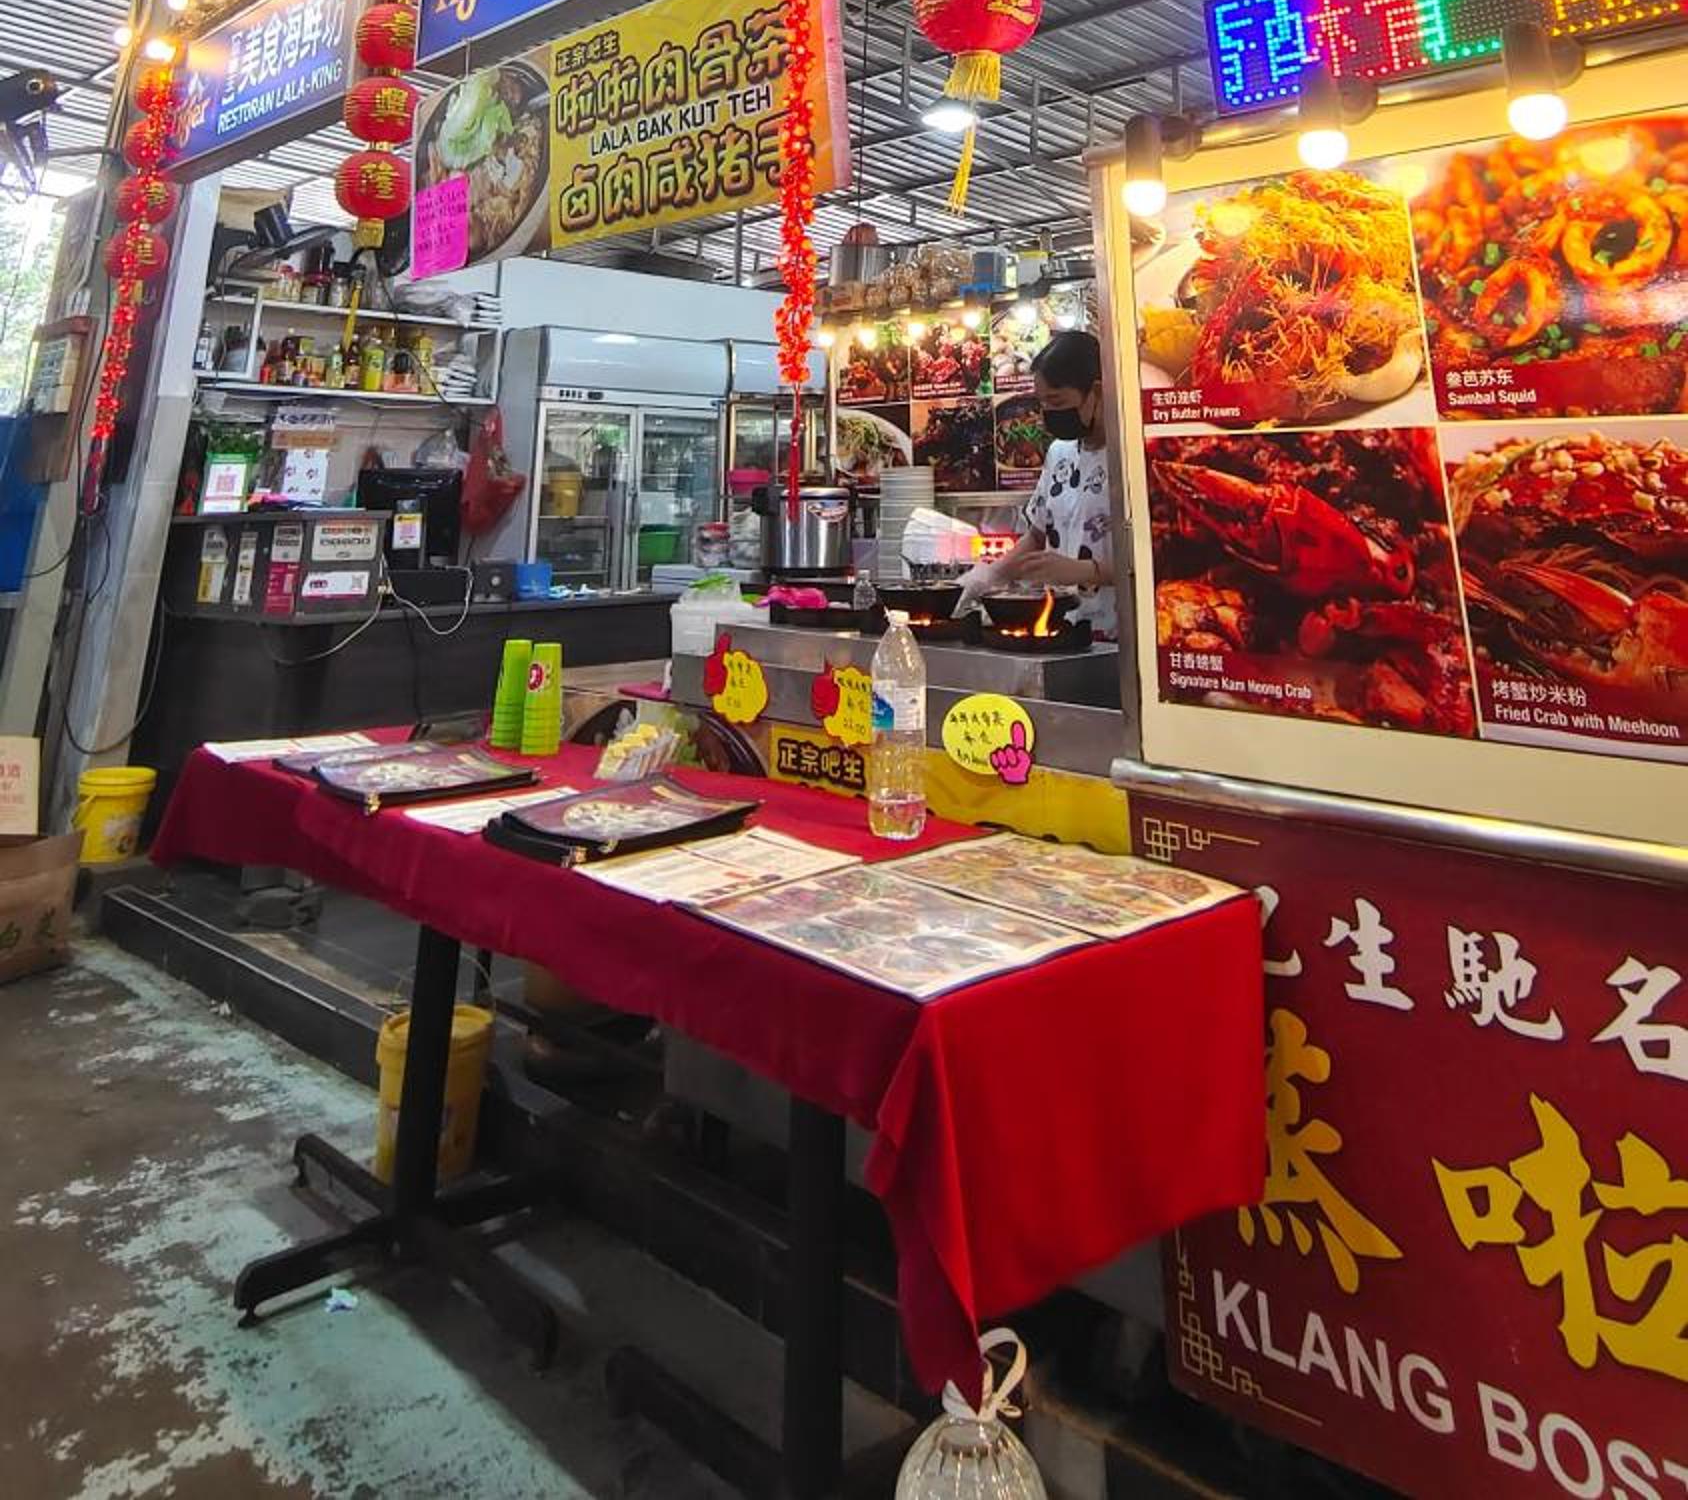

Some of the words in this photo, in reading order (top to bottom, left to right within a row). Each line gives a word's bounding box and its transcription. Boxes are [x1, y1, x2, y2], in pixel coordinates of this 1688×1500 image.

[556, 31, 620, 75] 正宗吧生
[557, 1, 793, 137] 啦啦肉骨茶
[217, 90, 275, 135] RESTORAN
[275, 59, 343, 108] LALA-KING
[590, 127, 633, 157] LALA
[638, 114, 673, 143] BAK
[679, 101, 719, 131] KUT
[728, 85, 772, 114] TEH
[1152, 409, 1169, 422] Dry
[1171, 407, 1201, 420] Butter
[1203, 406, 1241, 418] Prawns
[1448, 390, 1496, 405] Sambal
[1498, 389, 1537, 405] Squid
[1169, 671, 1220, 689] Signature
[1221, 678, 1246, 692] Kam
[1285, 684, 1312, 699] Crab
[1495, 703, 1531, 722] Fried
[1534, 708, 1569, 726] Crab
[1571, 712, 1605, 730] with
[1608, 715, 1680, 739] Meehoon
[779, 739, 865, 787] 正宗吧生
[1213, 1269, 1455, 1435] KLANG
